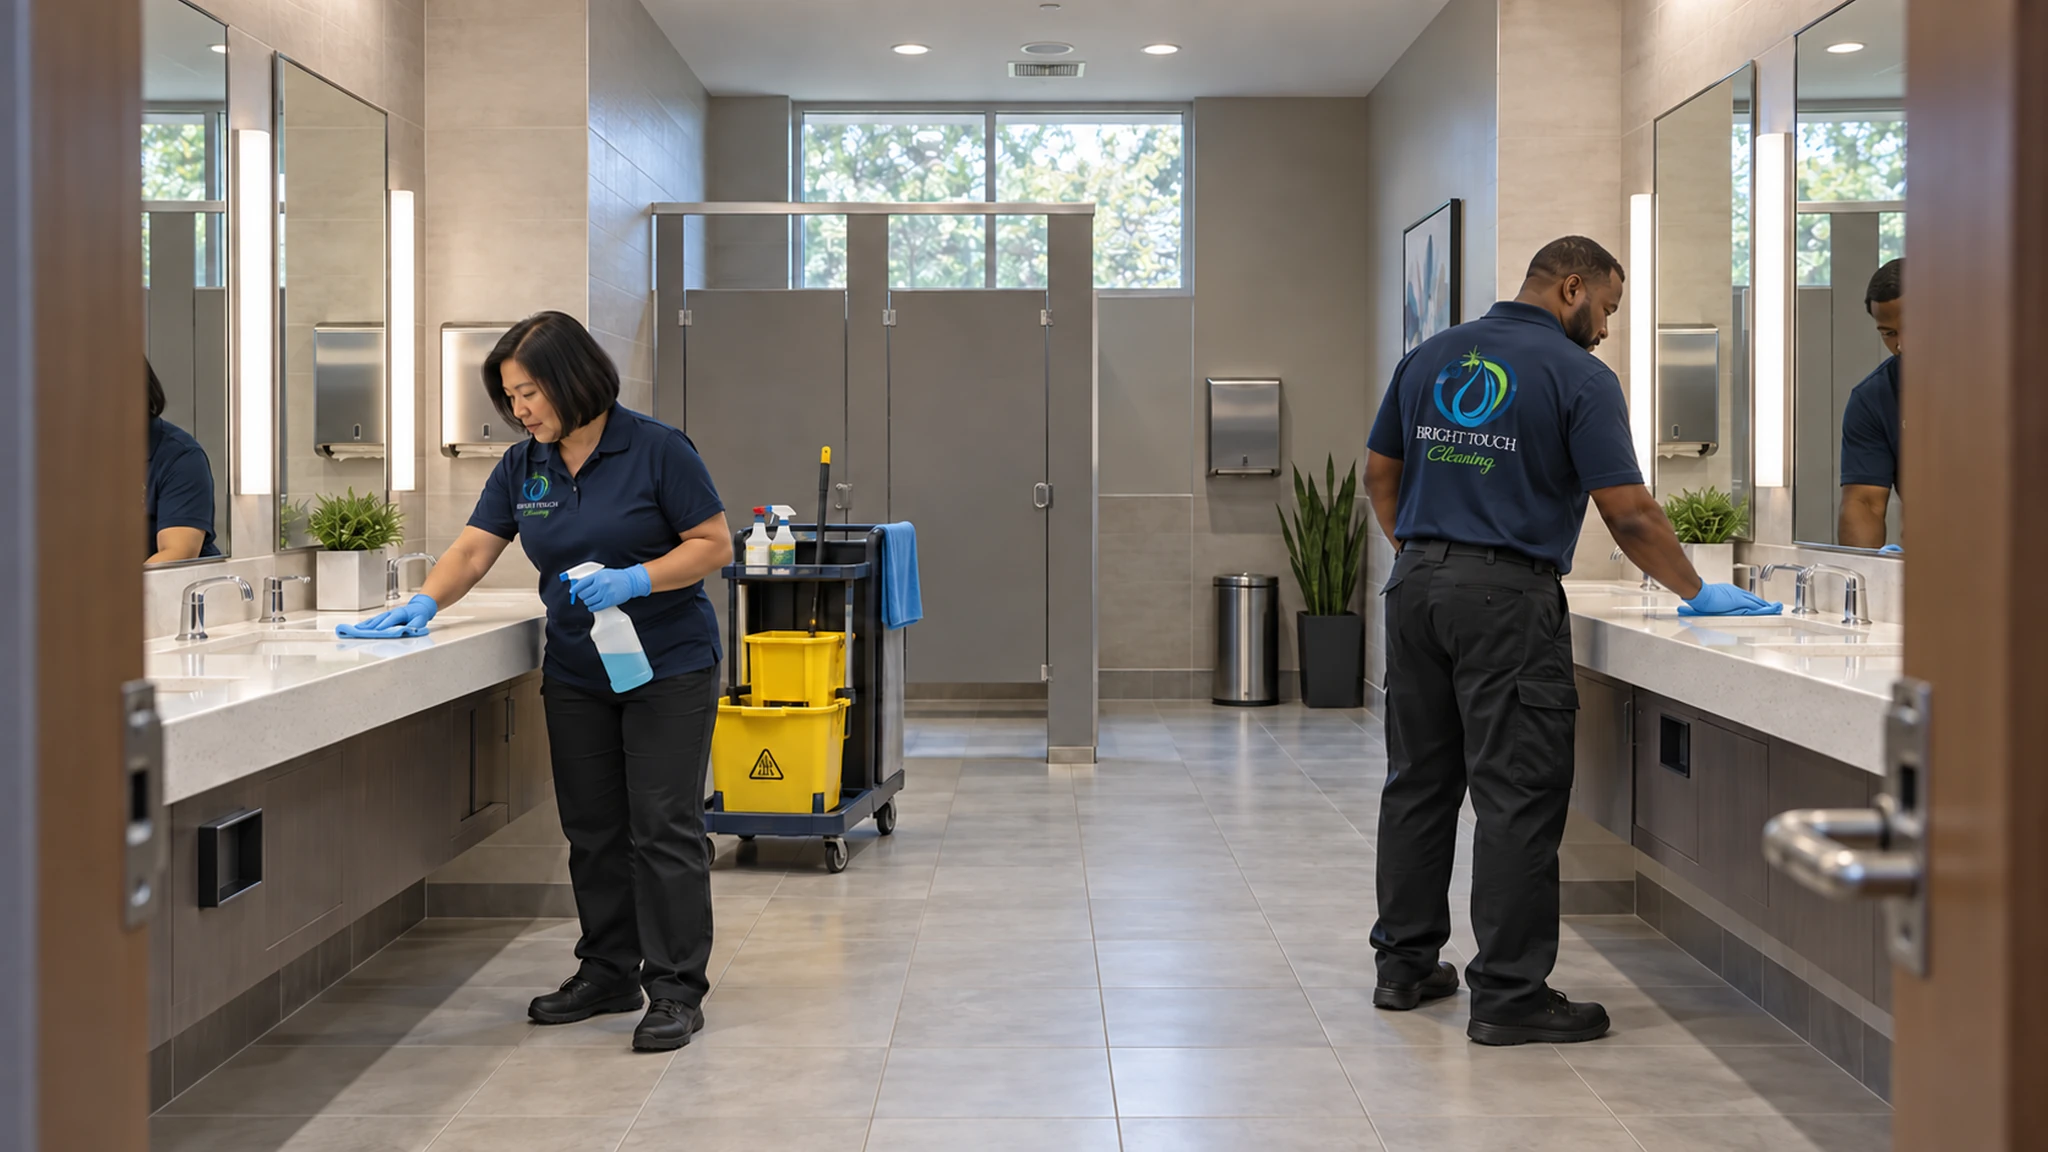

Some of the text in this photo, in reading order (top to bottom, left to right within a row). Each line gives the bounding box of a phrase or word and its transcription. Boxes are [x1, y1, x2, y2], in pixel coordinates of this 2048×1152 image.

[1416, 426, 1516, 451] BRIGHT TOUCH
[1427, 445, 1496, 474] Cleaning
